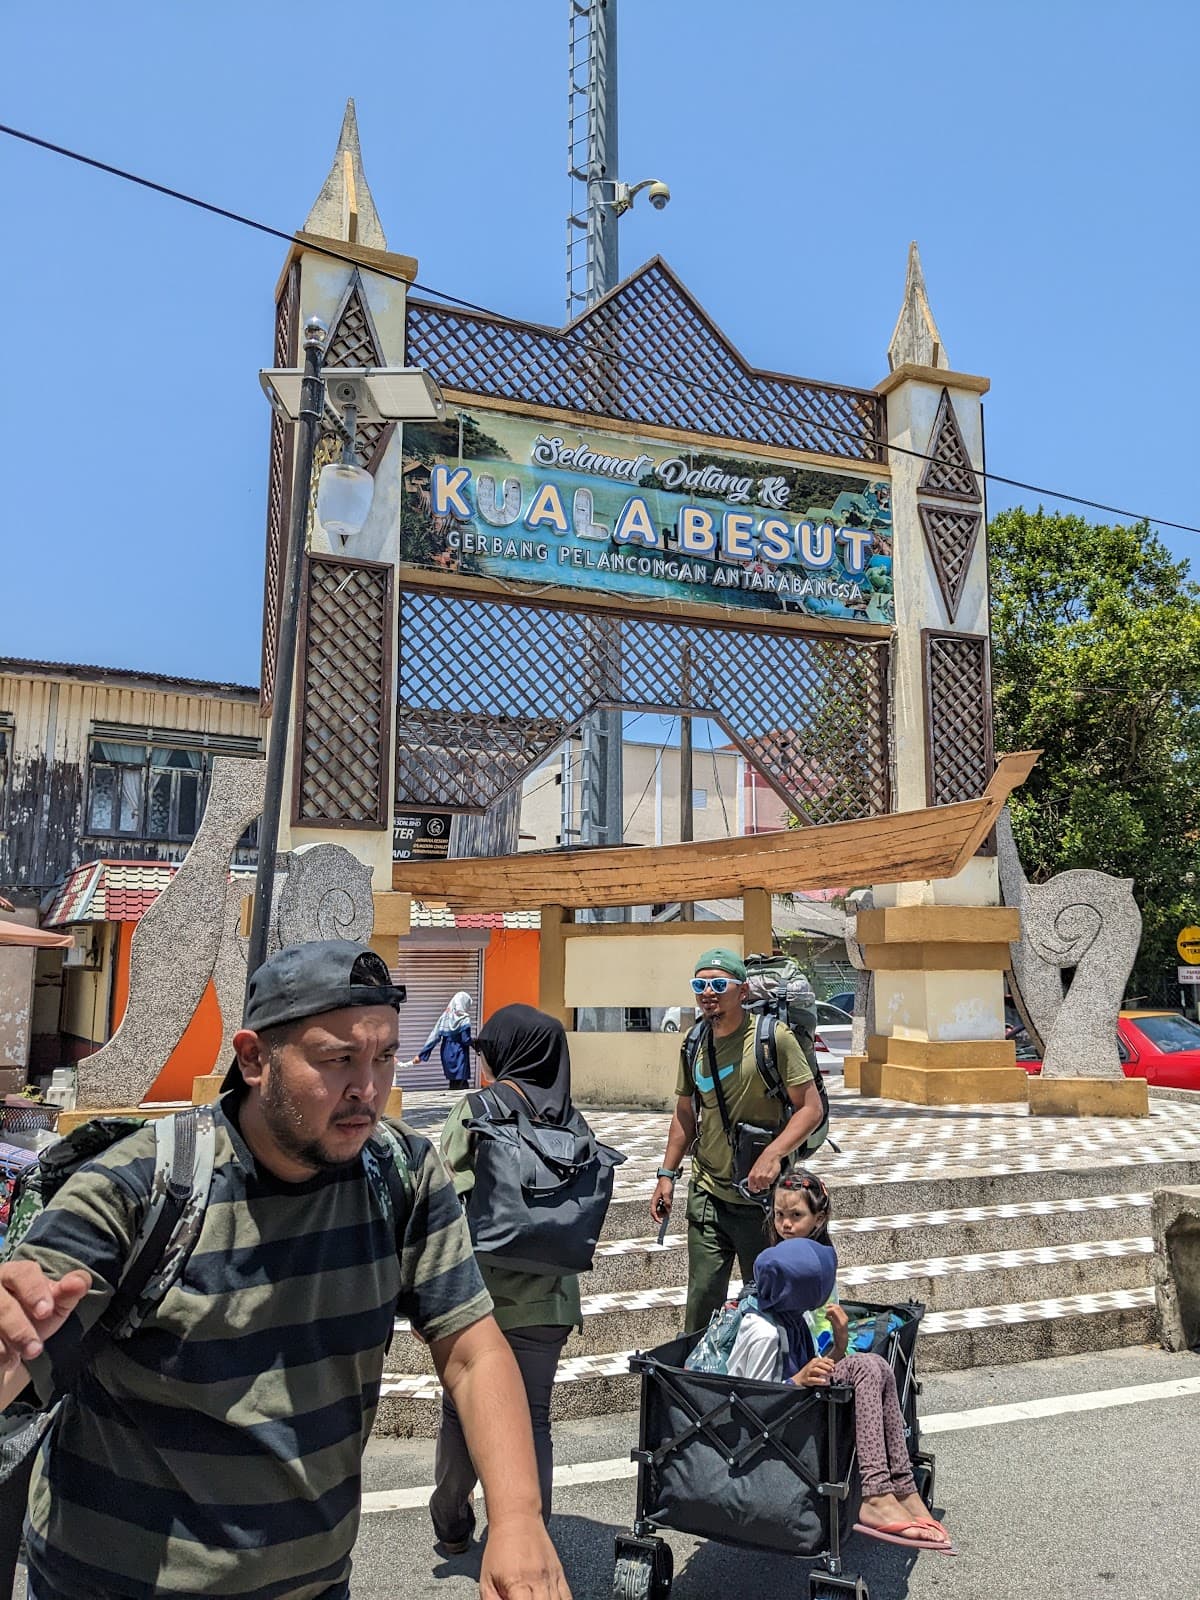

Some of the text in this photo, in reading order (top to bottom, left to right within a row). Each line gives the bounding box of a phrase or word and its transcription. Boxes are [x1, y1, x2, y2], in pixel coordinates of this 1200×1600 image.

[532, 434, 793, 507] Selamat Datang Ke
[430, 464, 874, 574] KUALA BESUT
[448, 530, 864, 601] GERBANG PELANCONGAN ANTARABANGSA
